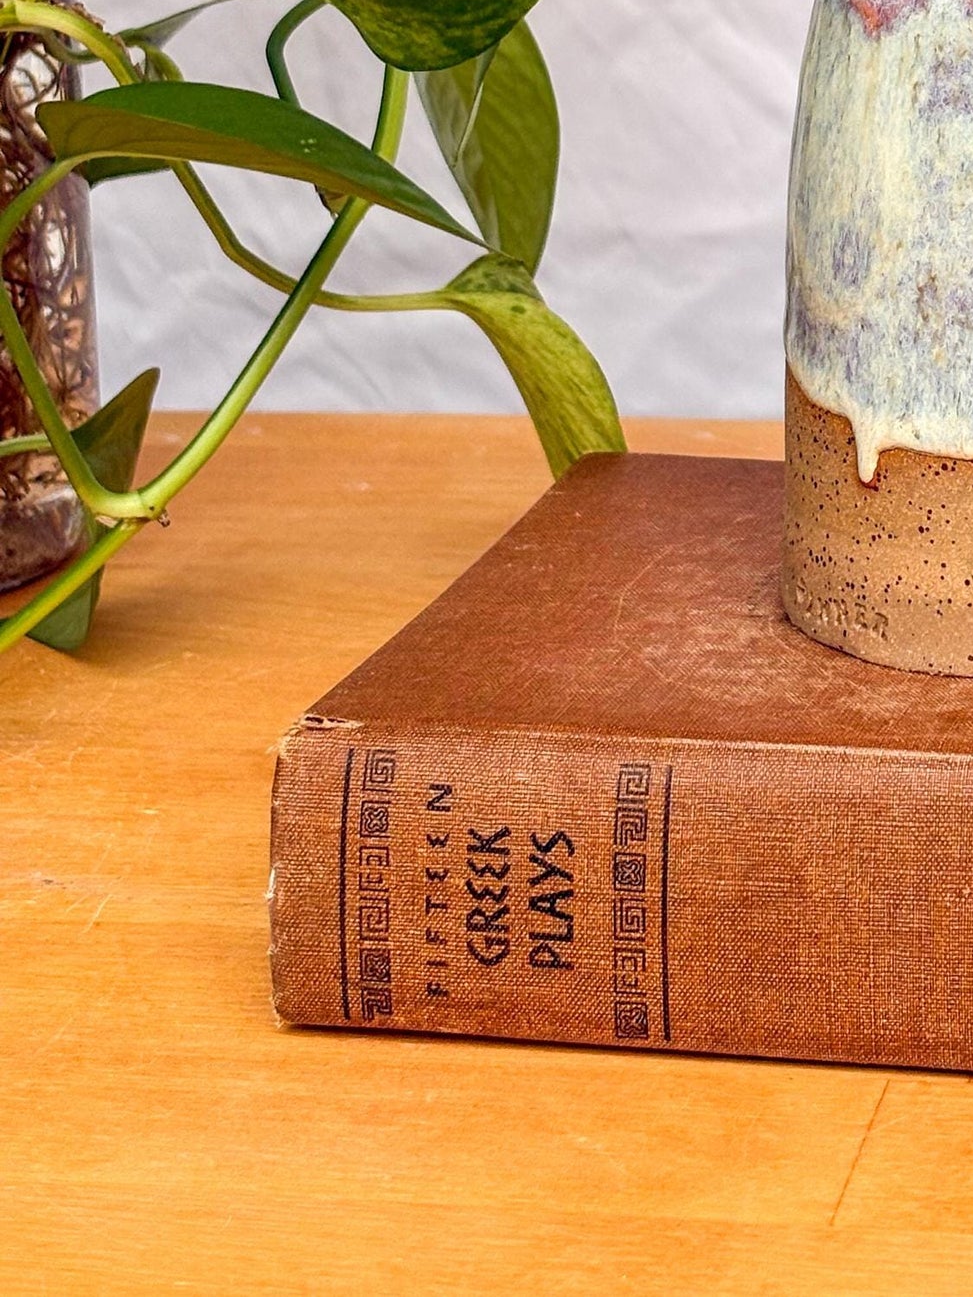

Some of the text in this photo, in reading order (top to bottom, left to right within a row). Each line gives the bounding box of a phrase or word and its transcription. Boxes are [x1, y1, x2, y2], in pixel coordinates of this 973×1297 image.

[425, 783, 453, 998] FIFTEEN
[466, 826, 511, 967] GREEK
[529, 830, 576, 970] PLAYS
